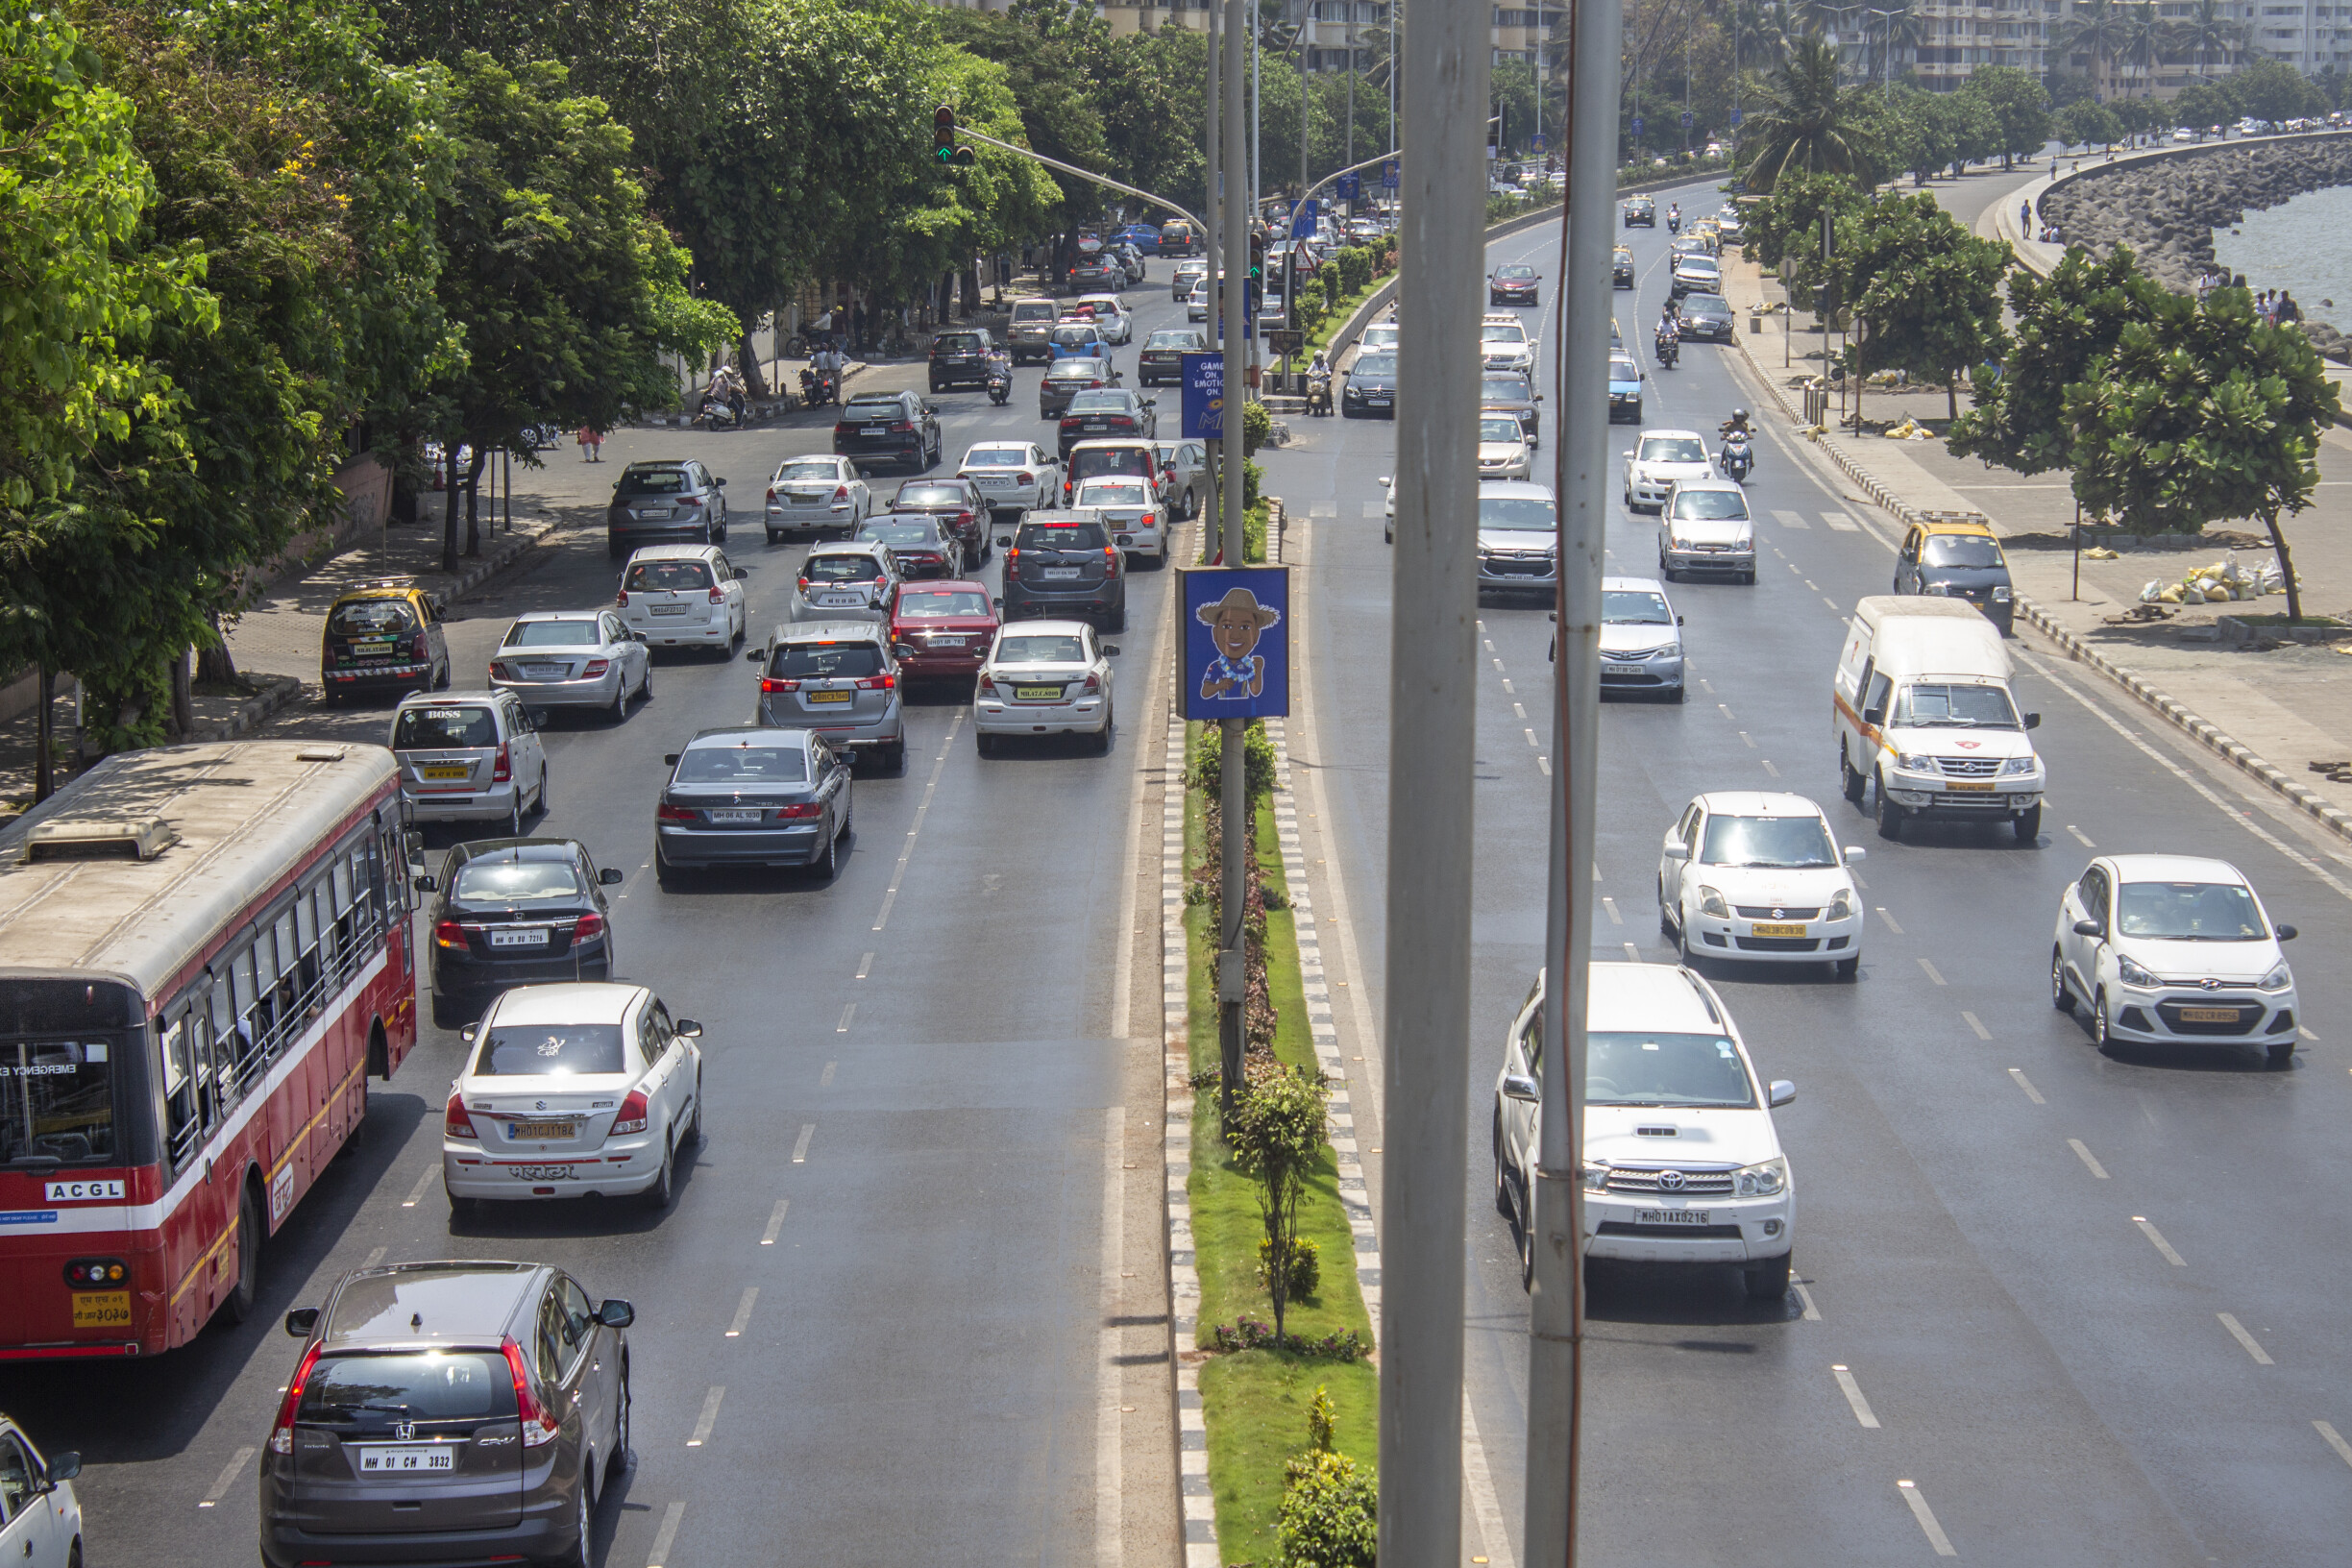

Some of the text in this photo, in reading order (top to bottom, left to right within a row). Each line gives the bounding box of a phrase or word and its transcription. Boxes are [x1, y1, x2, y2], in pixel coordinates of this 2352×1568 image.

[1201, 362, 1224, 371] GAME
[429, 710, 461, 719] BOSS
[735, 810, 745, 819] AL
[746, 809, 760, 818] 1030
[495, 935, 505, 943] MH
[515, 1124, 574, 1137] MH01CJ1184
[1642, 1211, 1707, 1223] MH01AX0216
[364, 1457, 450, 1468] MH 01 CH 3832
